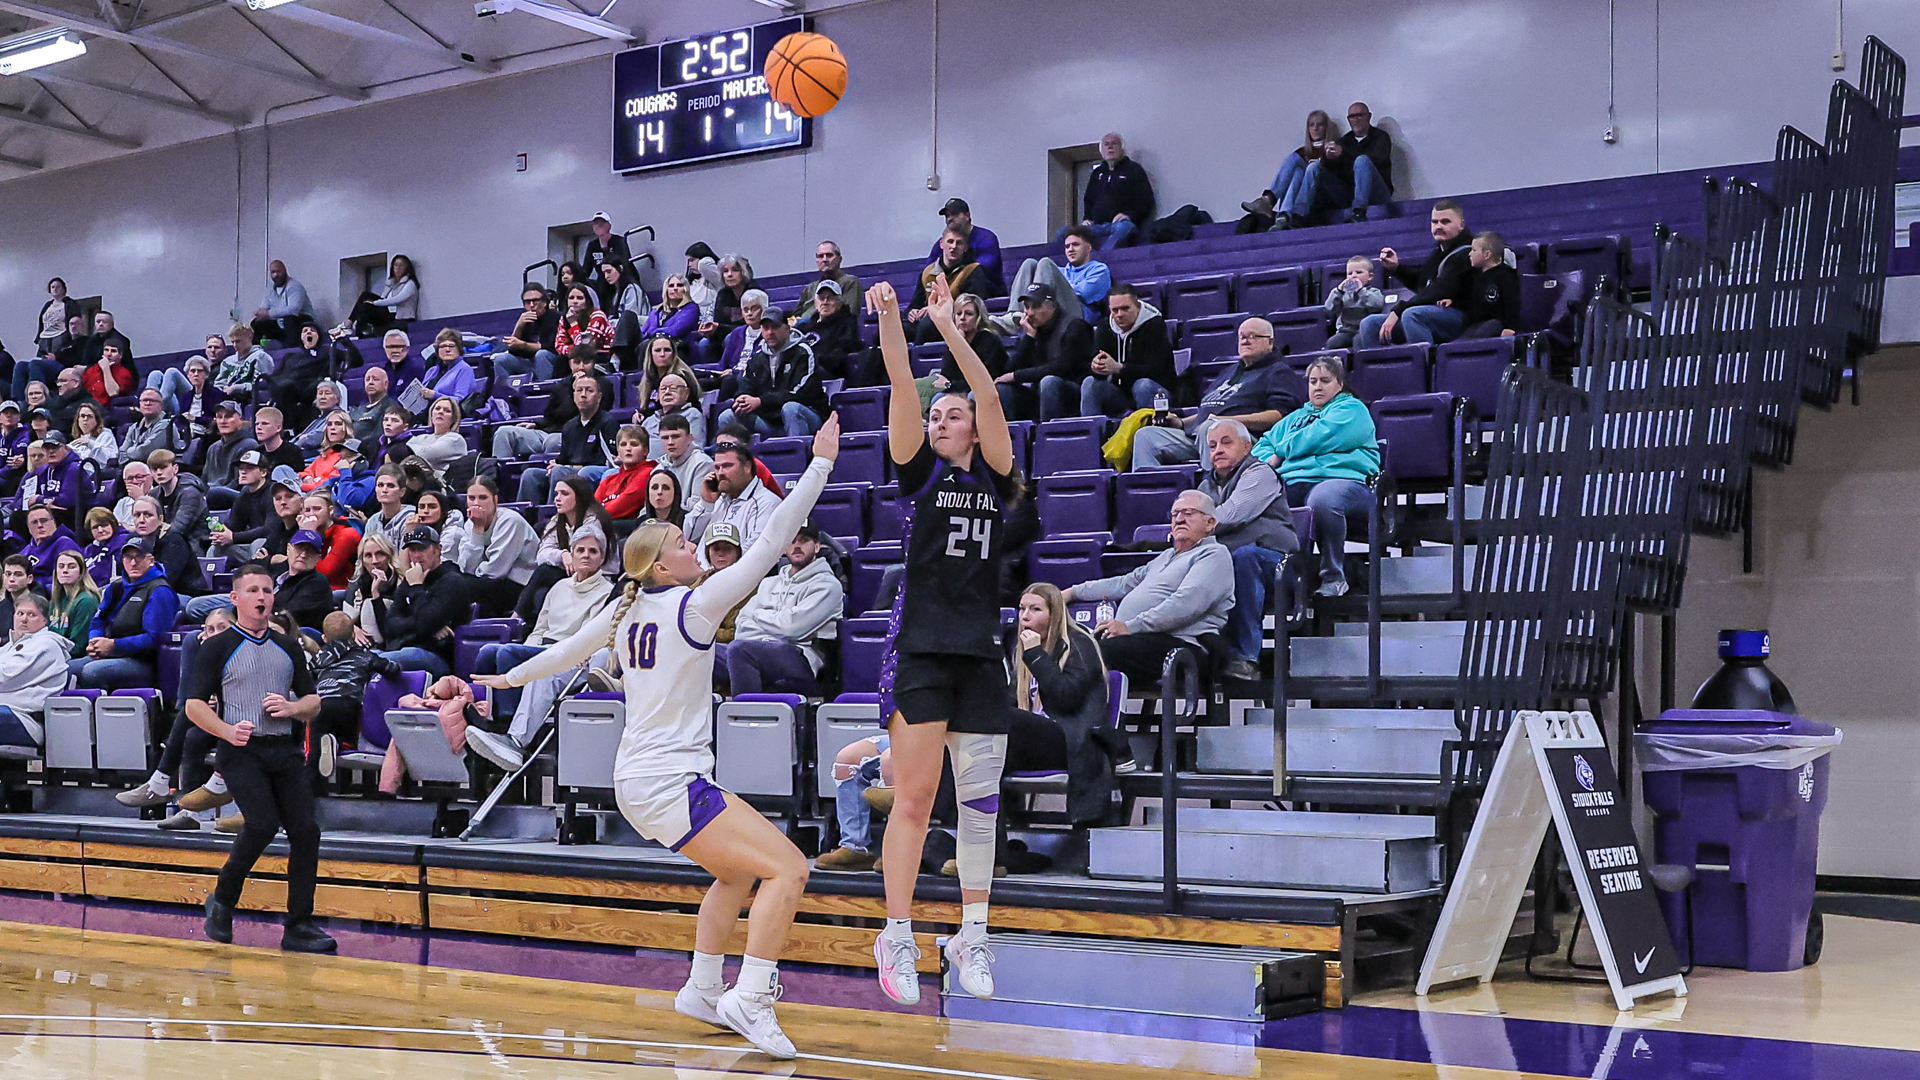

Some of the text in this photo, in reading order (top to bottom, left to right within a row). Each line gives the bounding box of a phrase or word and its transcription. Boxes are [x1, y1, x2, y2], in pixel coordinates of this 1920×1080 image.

[682, 32, 749, 80] 2:52
[626, 92, 677, 117] COUGARS
[687, 94, 721, 112] PERIOD
[705, 115, 712, 142] 1
[765, 101, 793, 136] 14
[638, 120, 664, 156] 14
[935, 490, 973, 509] SIOUX
[945, 515, 992, 560] 24
[1078, 612, 1088, 620] 37
[627, 621, 659, 670] 10
[1571, 791, 1614, 808] SIOUX FALLS
[1586, 846, 1638, 869] RESERVED
[1600, 870, 1642, 894] SEATING
